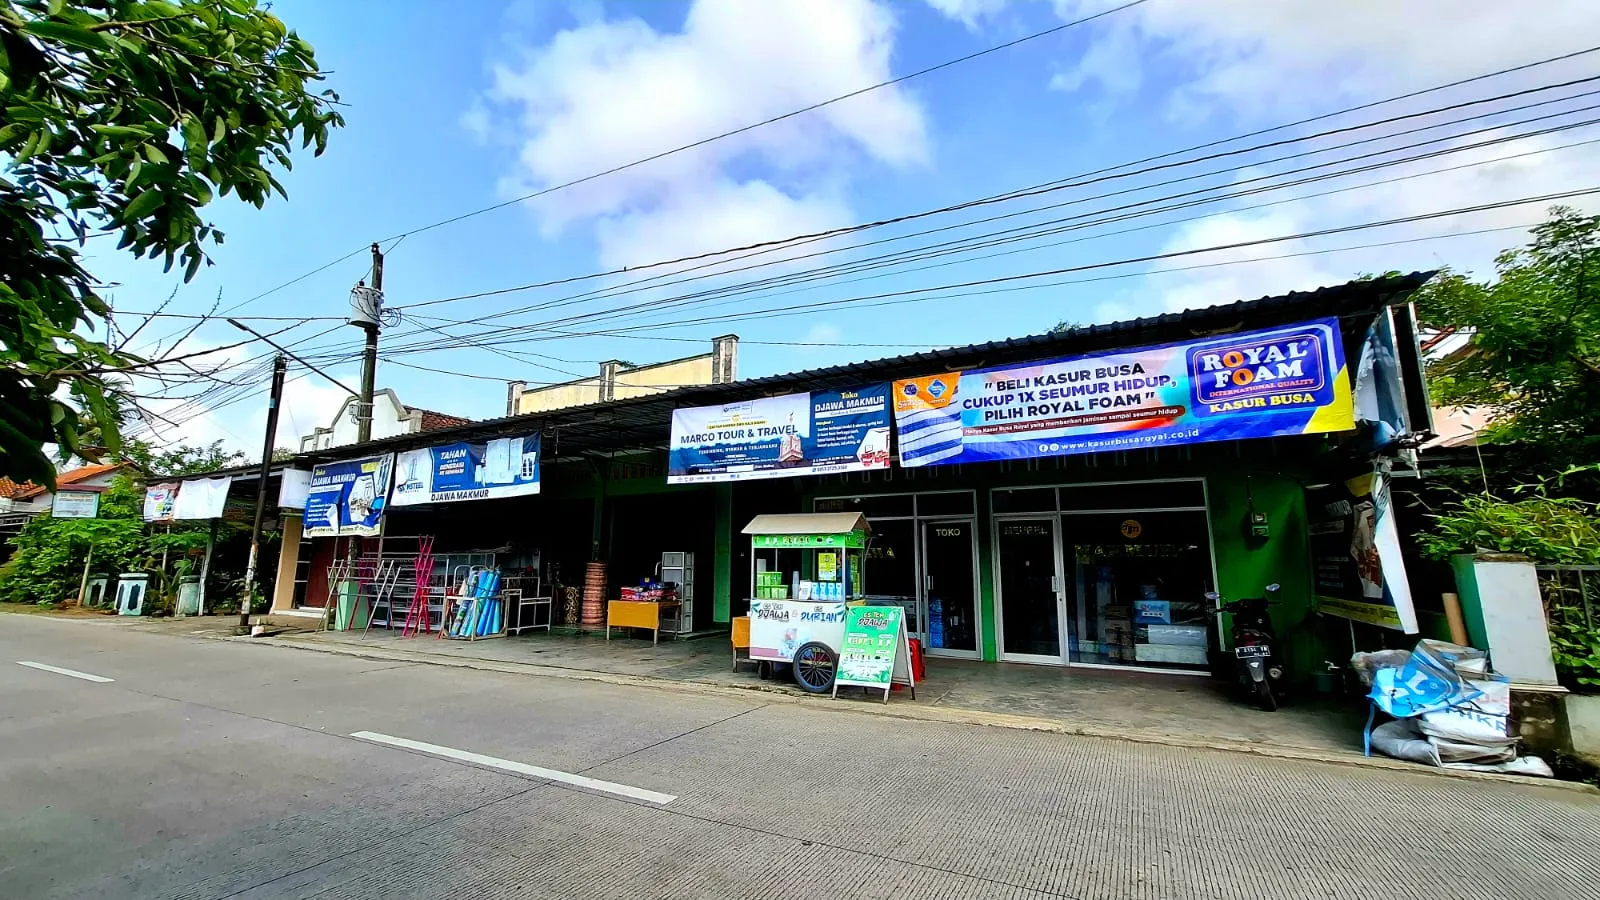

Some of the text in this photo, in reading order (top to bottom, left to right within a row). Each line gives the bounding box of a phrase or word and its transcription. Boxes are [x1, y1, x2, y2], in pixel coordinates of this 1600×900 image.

[1203, 342, 1308, 372] ROYAL
[996, 380, 1030, 392] BELI
[1033, 372, 1091, 388] KASUR
[1095, 362, 1146, 378] BUSA
[1213, 359, 1305, 388] FOAM
[840, 391, 859, 400] Toko
[962, 374, 1178, 410] CUKUP 1X SEUMUR HIDUP,
[1209, 378, 1315, 398] INTERNATIONAL QUALITY
[815, 402, 844, 412] DJAWA
[846, 395, 885, 409] MAKMUR
[984, 407, 1024, 421] PILIH
[1027, 400, 1085, 417] ROYAL
[1088, 393, 1142, 410] FOAM
[1209, 393, 1316, 413] KASUR BUSA
[1045, 417, 1082, 426] memberikan
[1108, 413, 1131, 421] sampai
[680, 432, 715, 444] MARCO
[718, 429, 745, 441] TOUR
[747, 428, 755, 438] &
[758, 424, 799, 437] TRAVEL
[1060, 428, 1200, 450] www.kasurbusaroyal.co.id
[440, 449, 467, 460] TAHAN
[312, 472, 356, 486] DJAWA MAKMUR
[430, 489, 489, 502] DJAWA MAKMUR
[935, 528, 961, 538] TOKO
[757, 609, 790, 620] DJAWA
[800, 611, 837, 622] DURIAN
[857, 617, 888, 627] DJAWA
